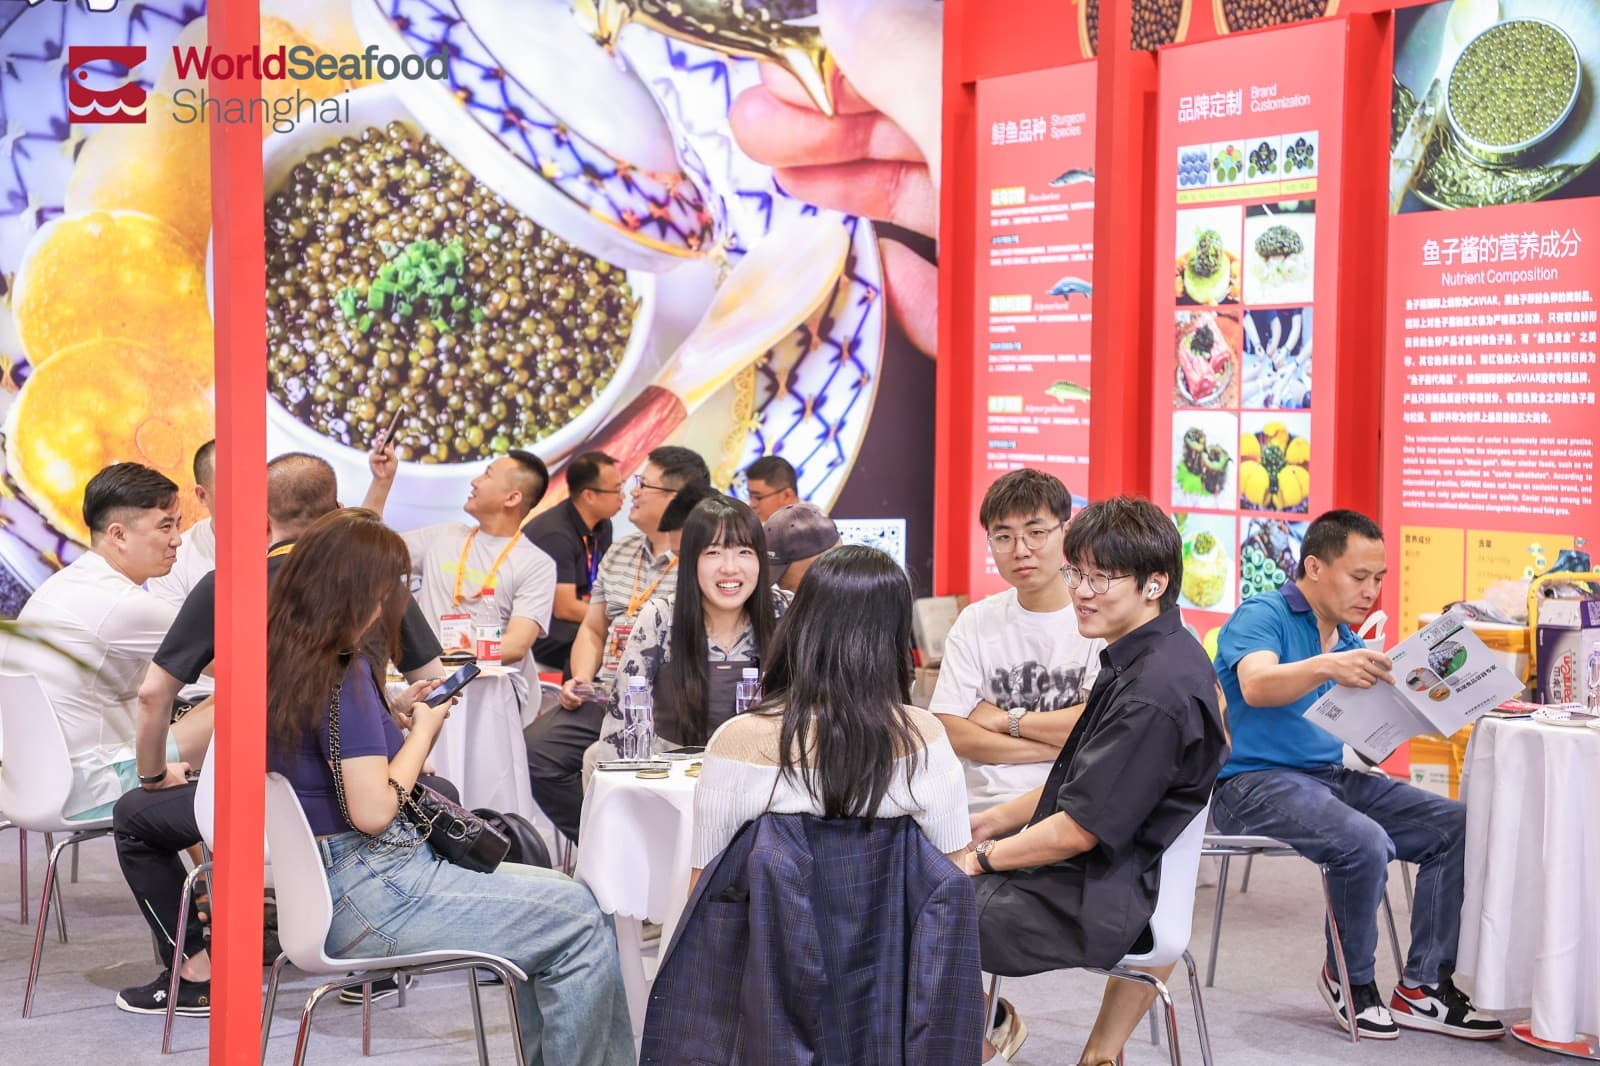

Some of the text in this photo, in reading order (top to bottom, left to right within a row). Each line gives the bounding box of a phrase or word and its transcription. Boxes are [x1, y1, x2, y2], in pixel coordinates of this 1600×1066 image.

[1251, 83, 1277, 99] Brand
[1178, 88, 1242, 123] 品牌定制
[1250, 94, 1311, 113] Customization
[1051, 112, 1086, 126] Sturgeon
[992, 117, 1046, 145] 鲟鱼品种
[1051, 126, 1081, 139] Species
[1422, 227, 1582, 266] 鱼子酱的营养成分
[1441, 267, 1558, 287] Nutrient Composition
